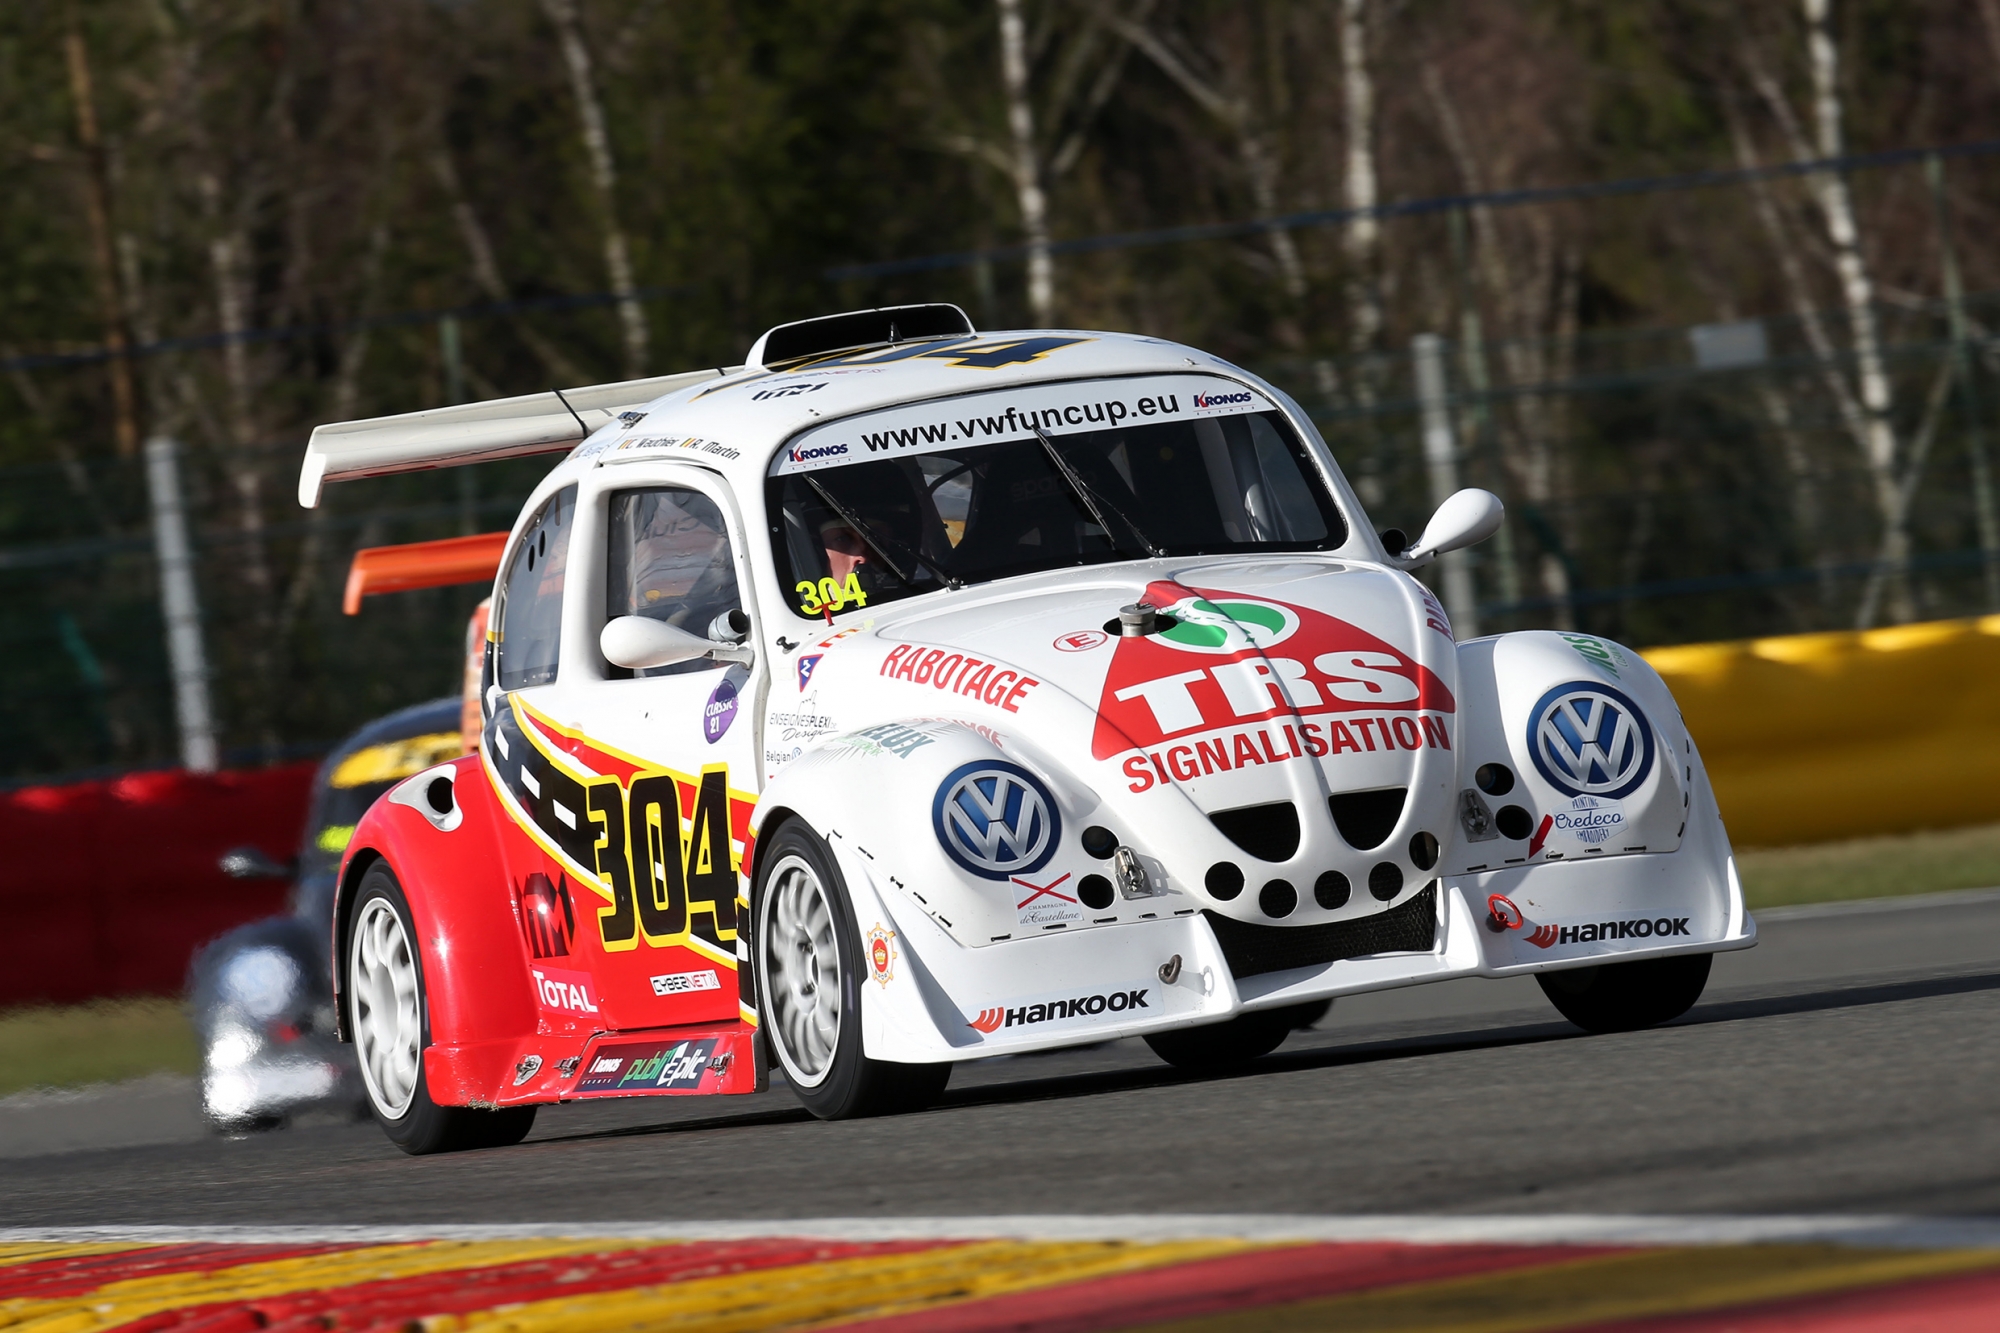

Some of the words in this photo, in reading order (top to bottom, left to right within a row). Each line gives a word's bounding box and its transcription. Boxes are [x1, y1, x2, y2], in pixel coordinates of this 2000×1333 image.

[1193, 390, 1252, 408] KRONOS
[861, 394, 1180, 452] www.vwfuncup.eu
[701, 441, 741, 460] Martin
[788, 444, 848, 462] KRONOS
[795, 573, 868, 615] 304
[879, 644, 1040, 714] RABOTAGE
[1113, 651, 1421, 735] TRS
[706, 697, 733, 718] CLASSIC
[710, 715, 720, 735] 21
[782, 728, 839, 743] Design
[766, 750, 791, 764] Belgian
[1122, 715, 1452, 794] SIGNALISATION
[1554, 811, 1625, 829] Credeco
[587, 762, 740, 952] 304
[1028, 902, 1068, 911] CHAMPAGNE
[1559, 917, 1691, 945] HANKOOK
[531, 969, 599, 1013] TOTAL
[1005, 988, 1150, 1028] HANKOOK
